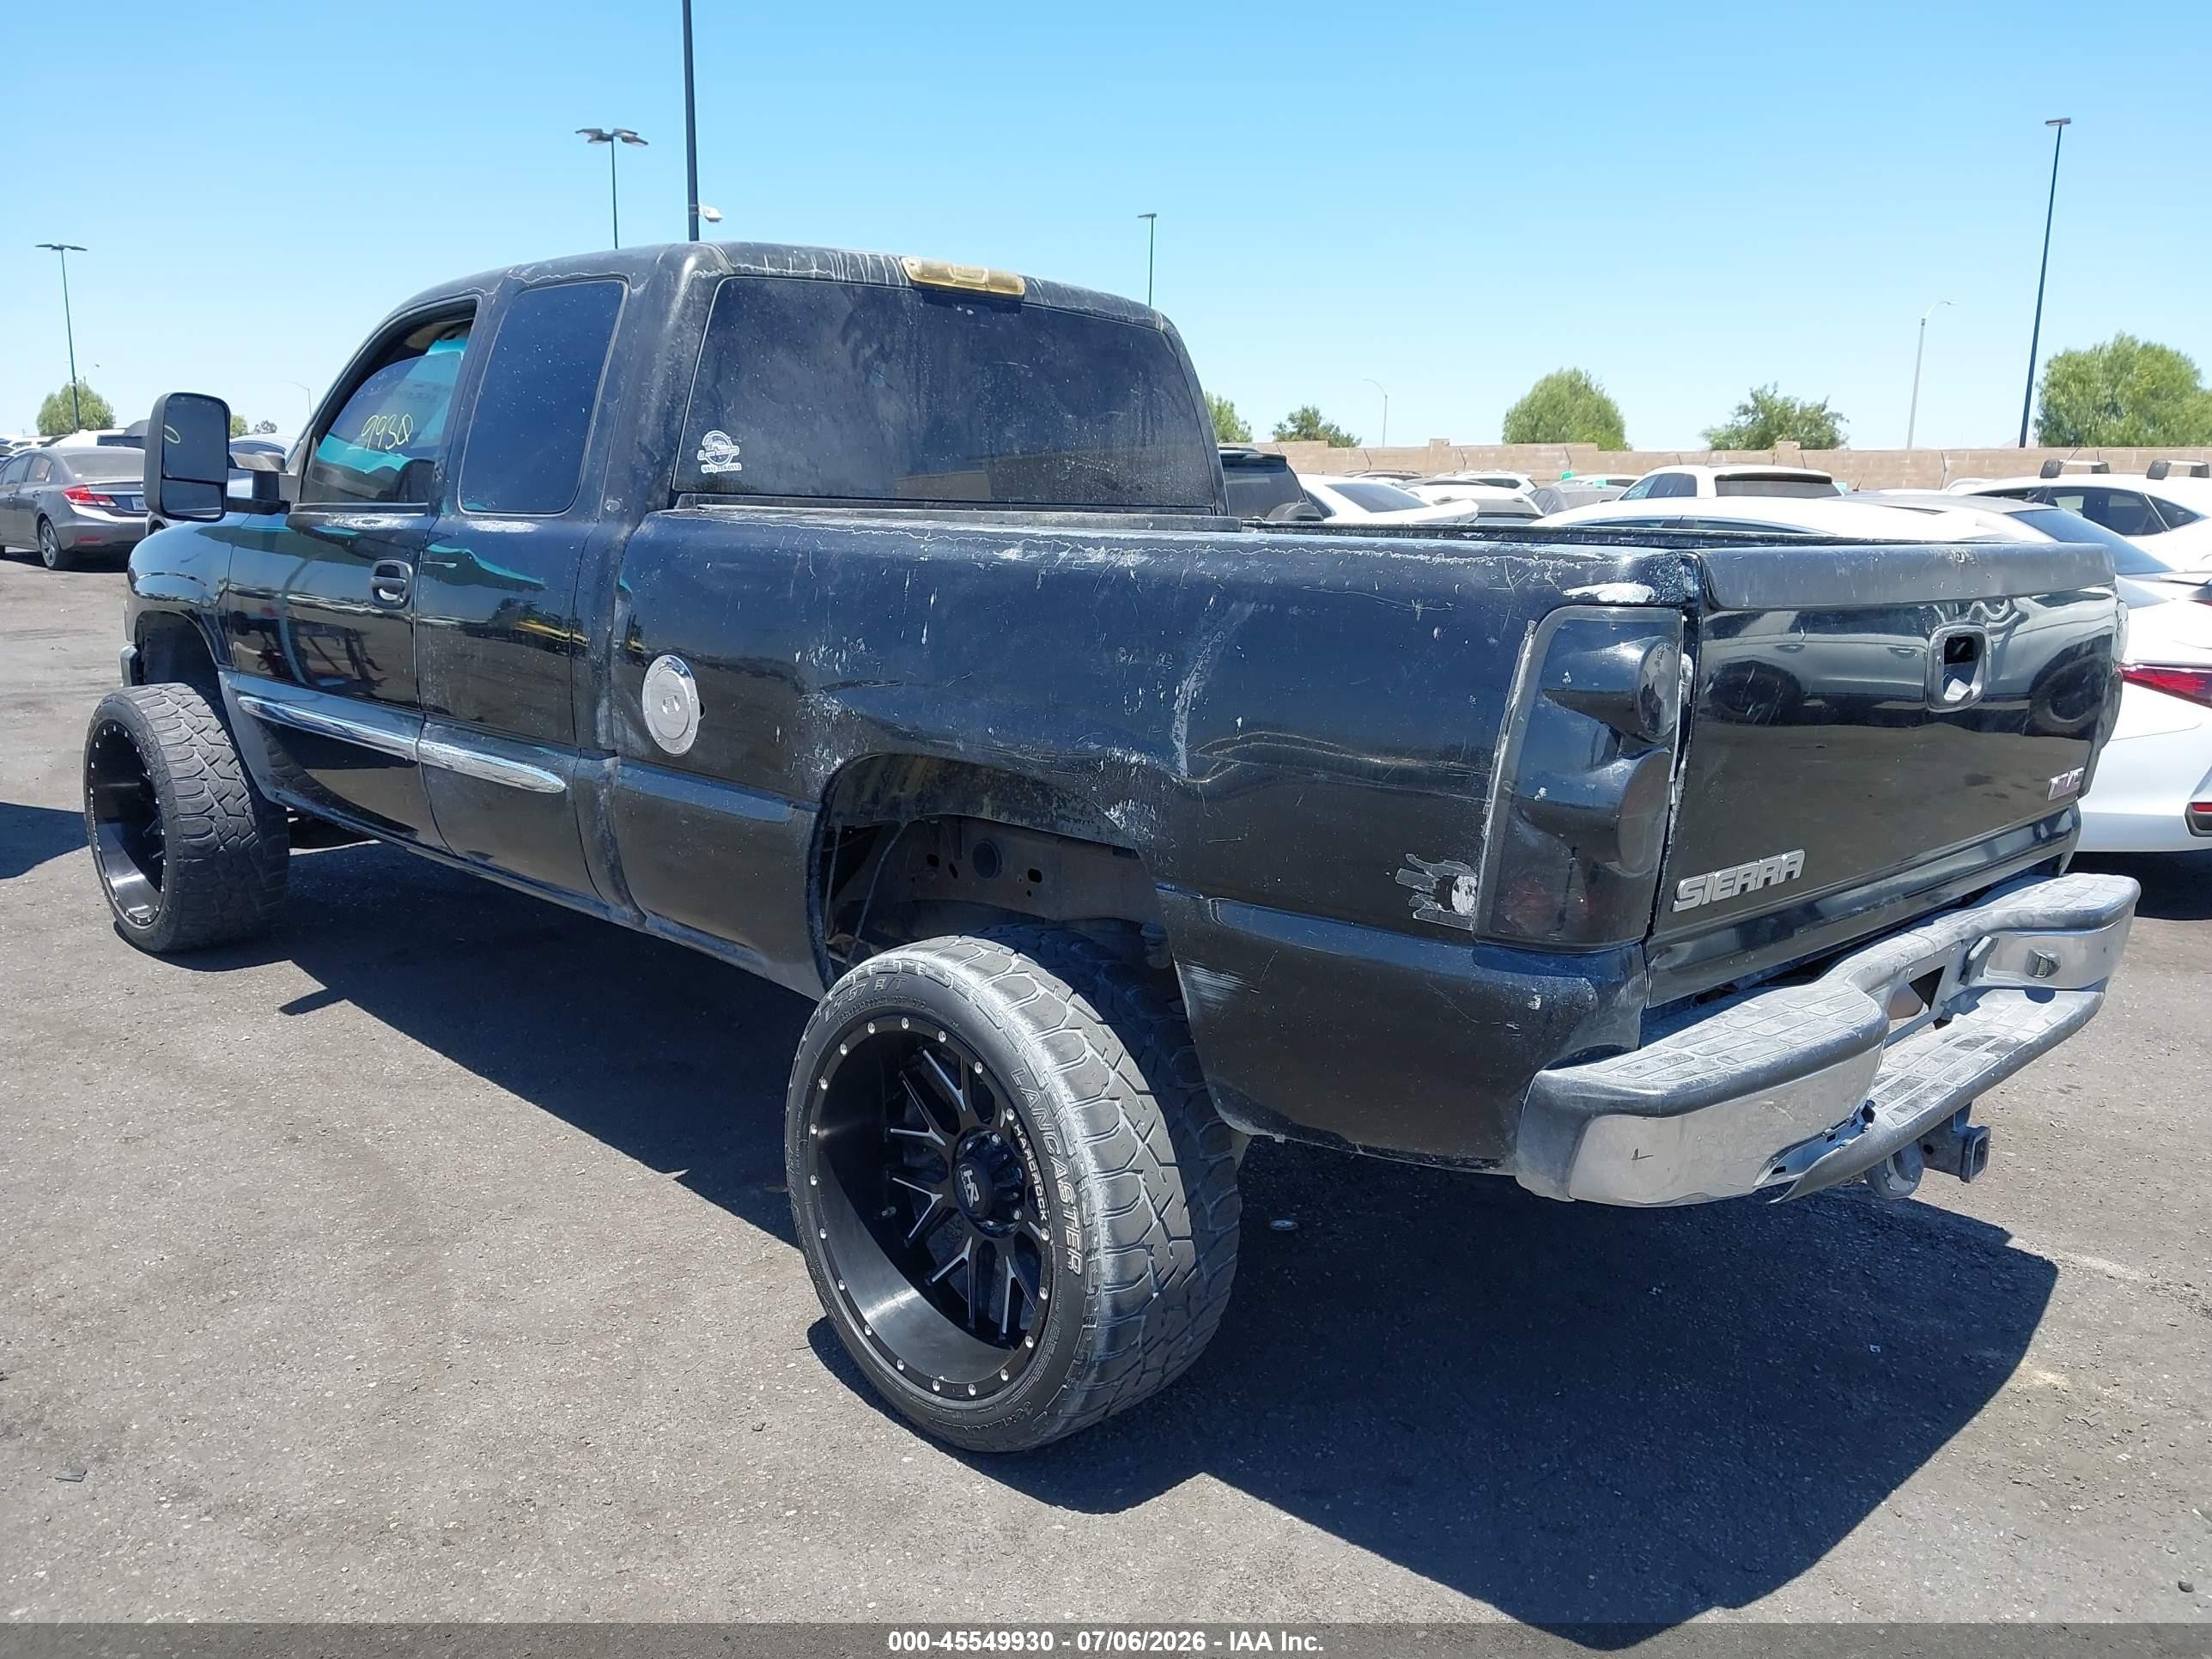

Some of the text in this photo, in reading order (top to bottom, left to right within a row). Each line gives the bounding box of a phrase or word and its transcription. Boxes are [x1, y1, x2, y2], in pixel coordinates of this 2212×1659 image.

[1673, 848, 1805, 913] SIERRA
[1011, 1068, 1083, 1276] LANCASTER
[1014, 1123, 1048, 1221] HARDROCK
